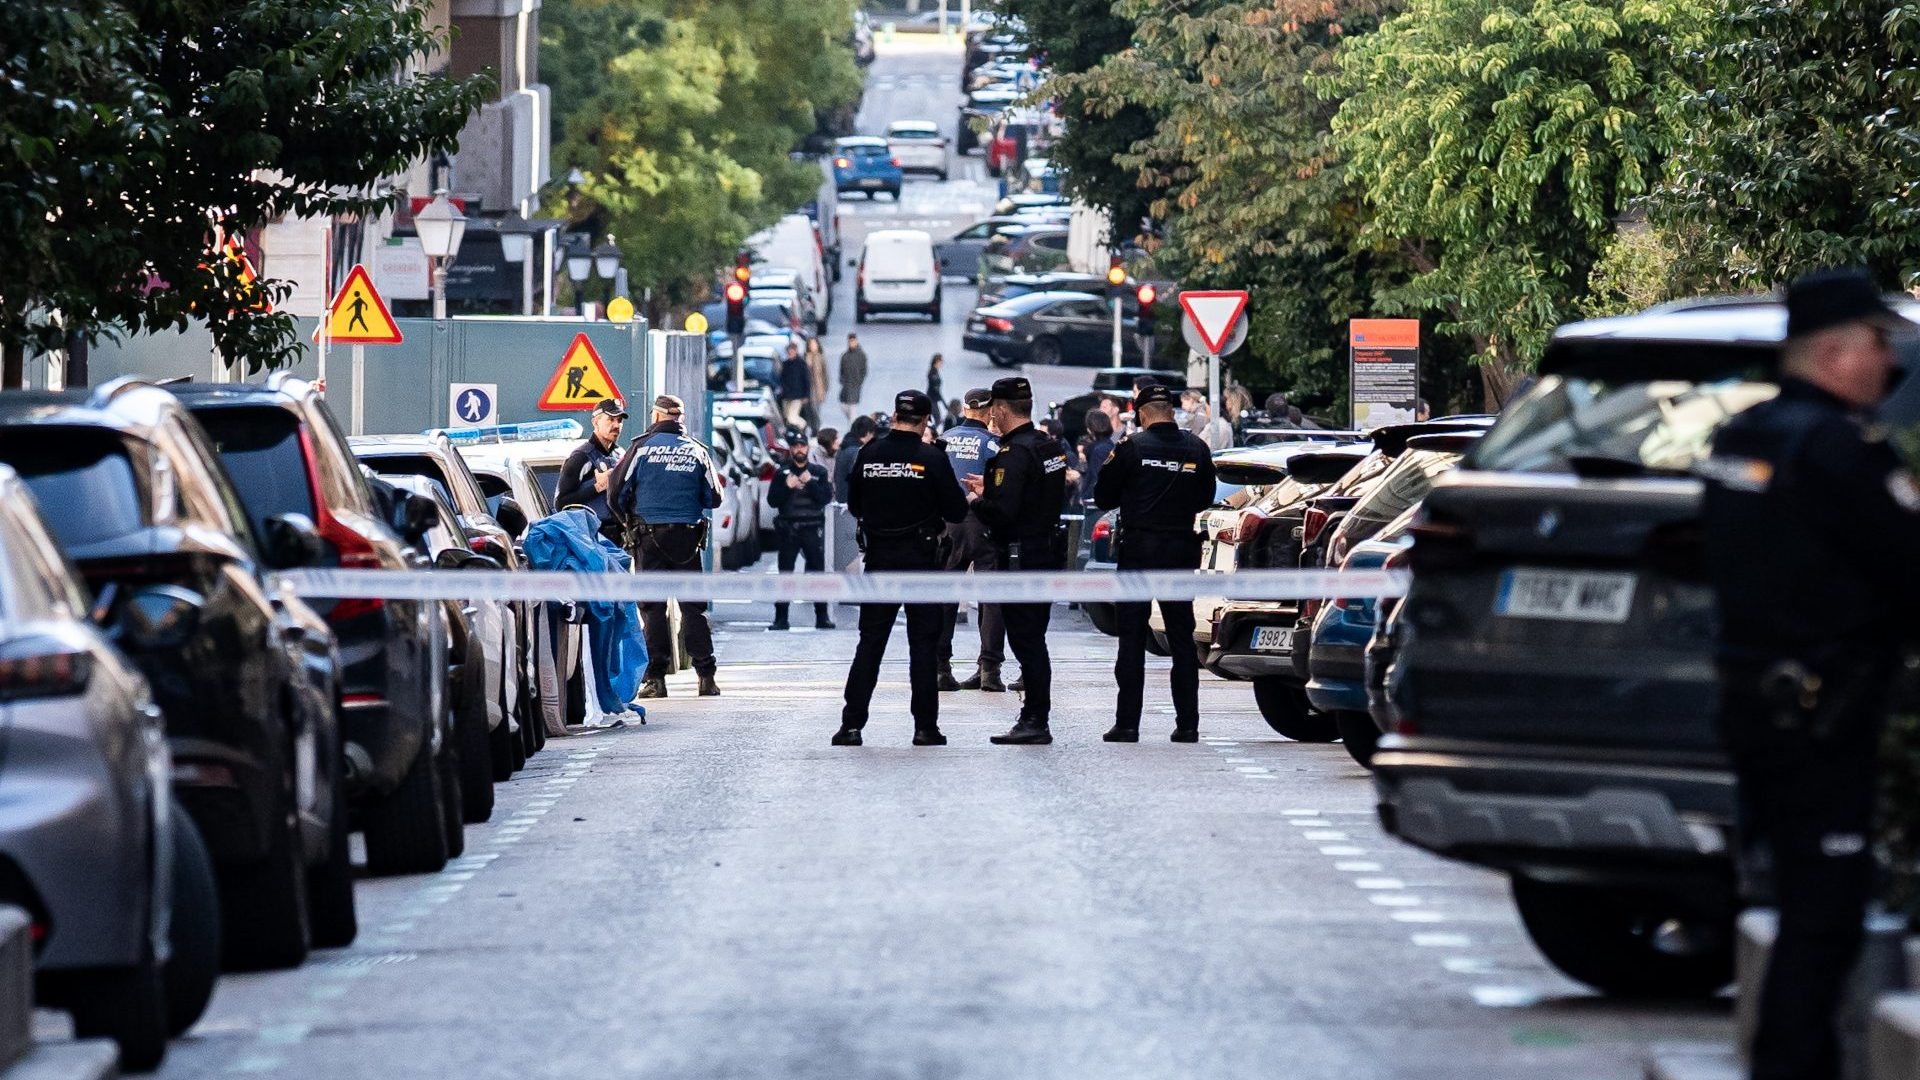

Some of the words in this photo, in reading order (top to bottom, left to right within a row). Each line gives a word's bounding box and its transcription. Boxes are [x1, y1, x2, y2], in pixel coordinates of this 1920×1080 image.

[648, 455, 697, 464] MUNICIPAL
[956, 452, 980, 460] Madrid
[665, 463, 696, 473] Madrid
[863, 463, 913, 471] POLICIA
[863, 470, 925, 479] NACIONAL
[1259, 630, 1287, 646] 3982
